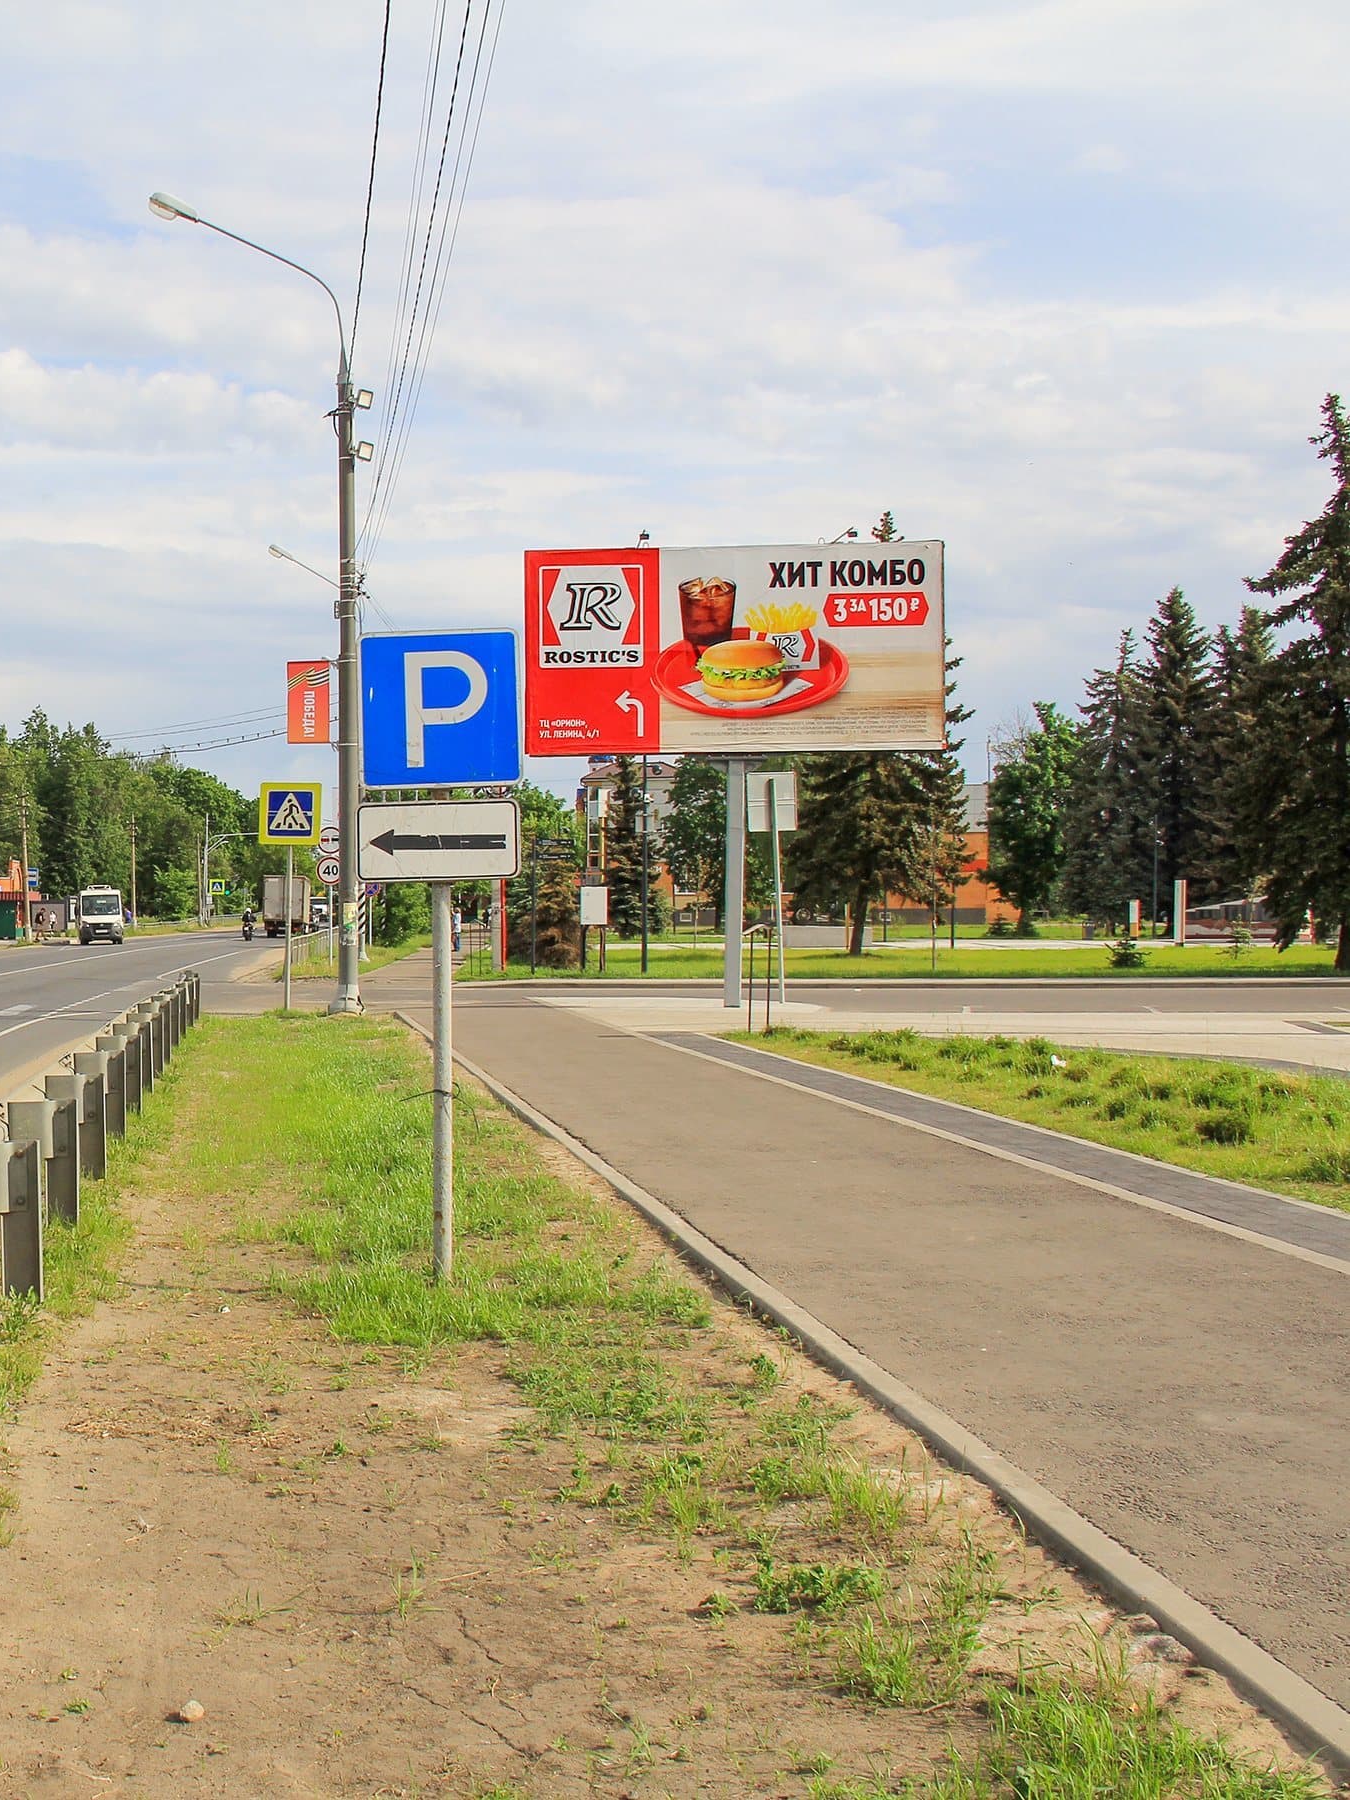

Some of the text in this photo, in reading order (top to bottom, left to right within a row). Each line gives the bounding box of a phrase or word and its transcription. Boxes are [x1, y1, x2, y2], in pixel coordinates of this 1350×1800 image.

[769, 559, 925, 588] ХИТ КОМБО
[544, 650, 639, 664] ROSTIC'S
[302, 690, 316, 738] ПОБЕДА!
[403, 650, 488, 768] P
[539, 719, 550, 729] ТЦ
[539, 730, 600, 739] УЛ. ЛЕНИНА, 4/1
[322, 864, 339, 876] 40
